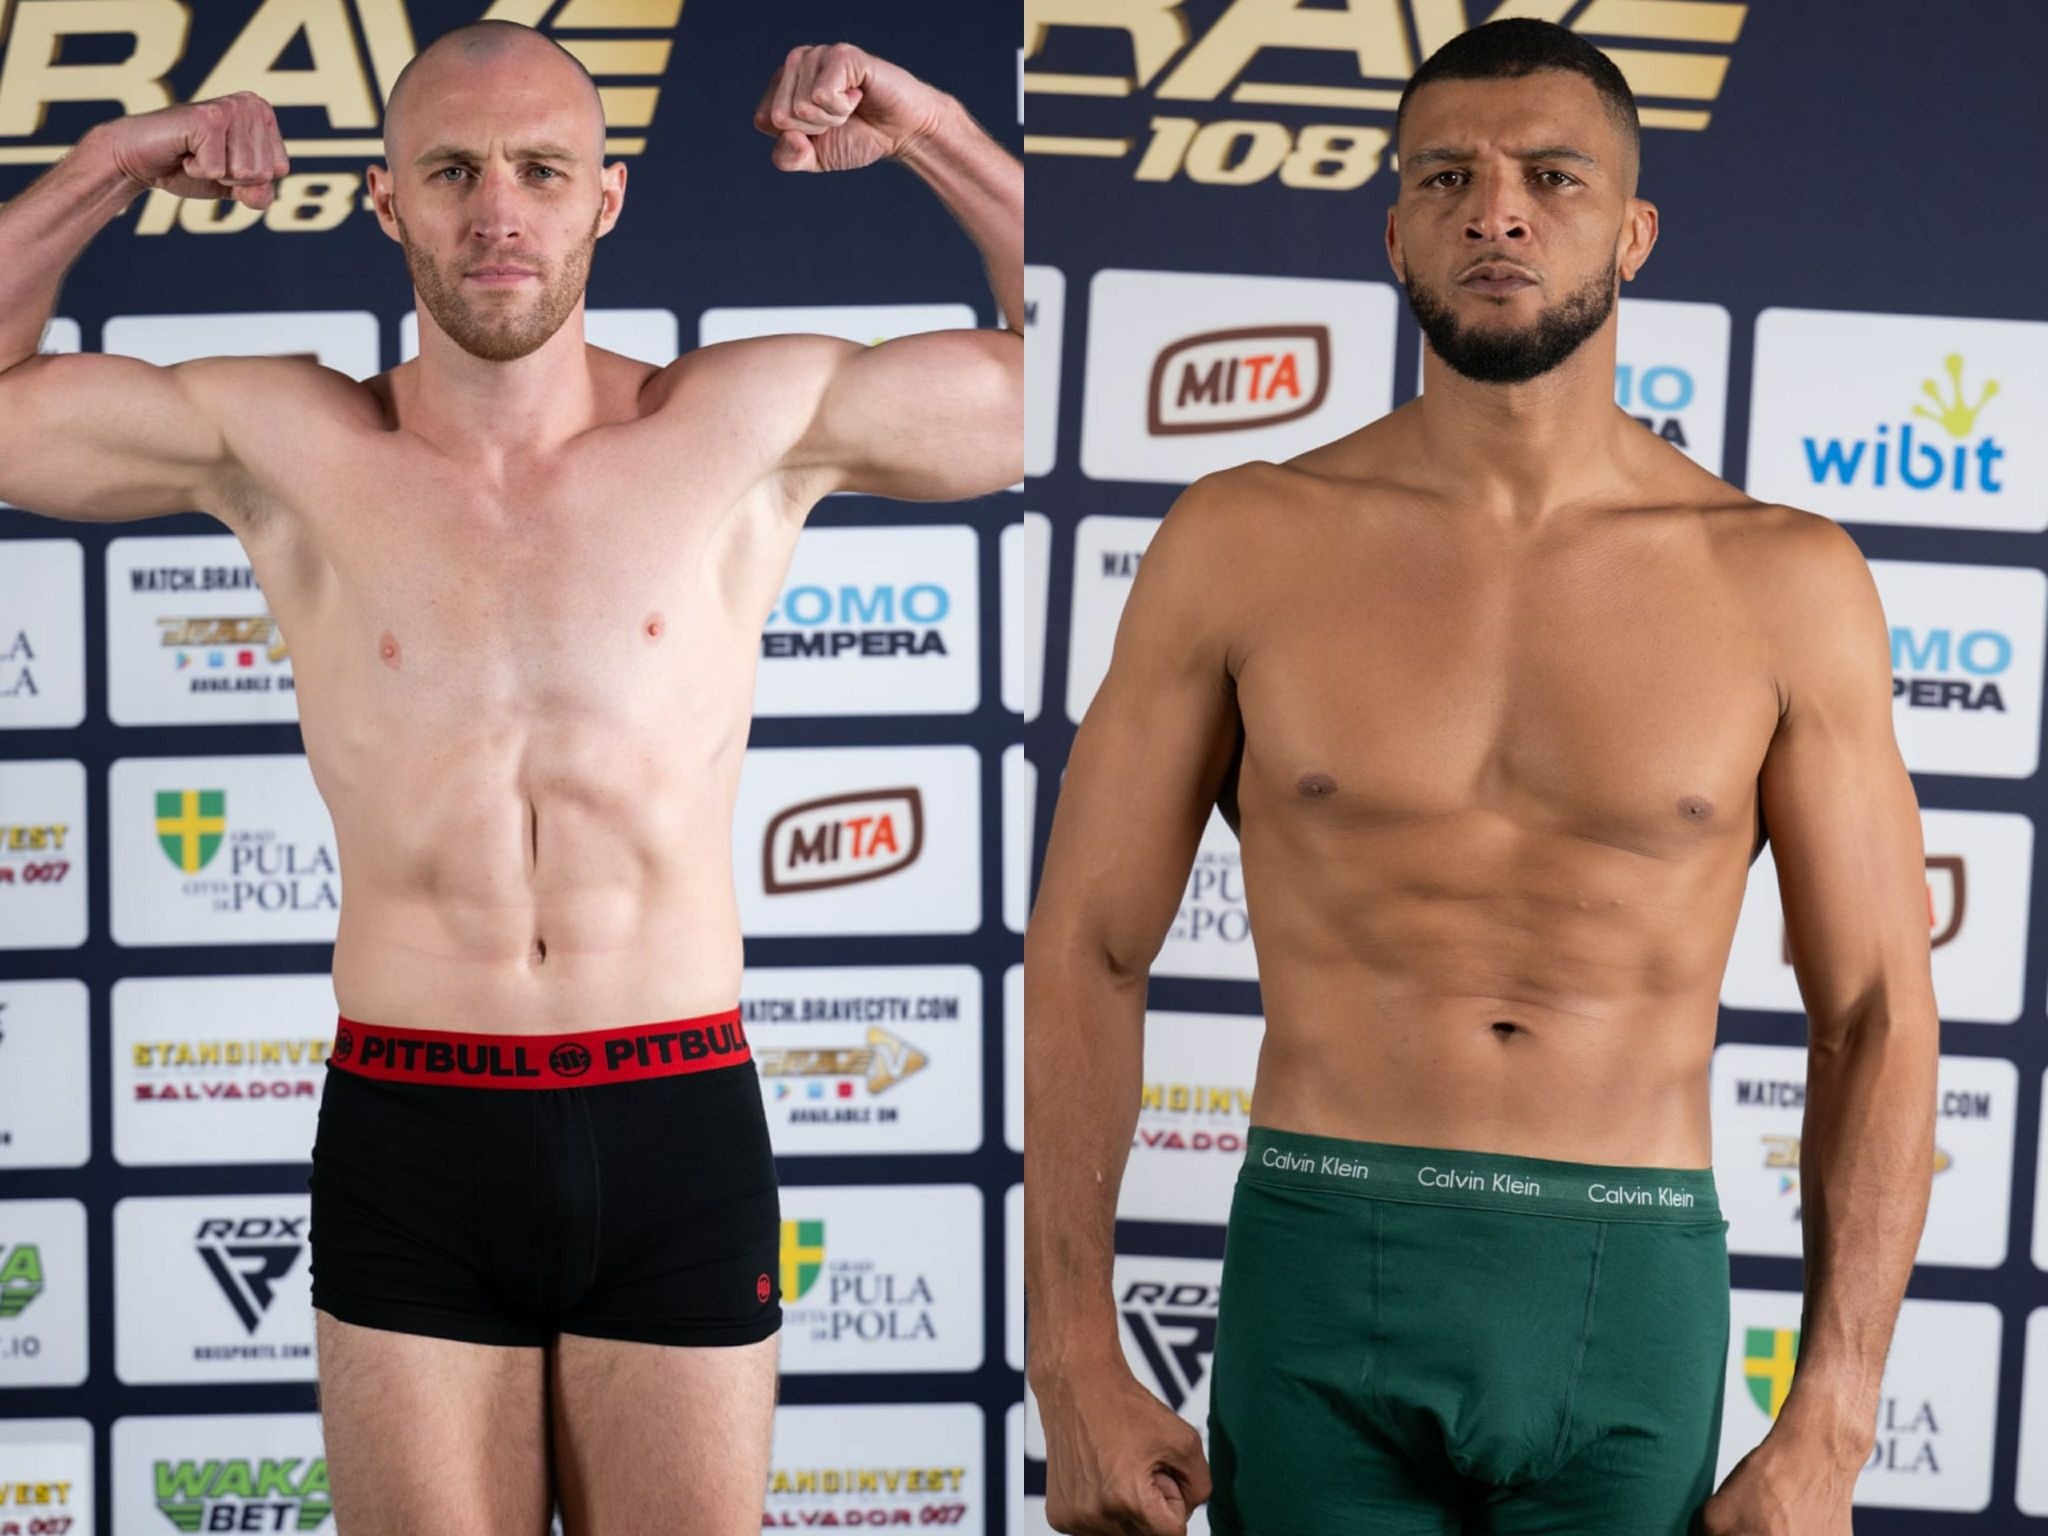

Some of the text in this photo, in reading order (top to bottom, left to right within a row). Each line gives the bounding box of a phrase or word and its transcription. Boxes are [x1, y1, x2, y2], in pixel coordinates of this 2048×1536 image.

[1134, 116, 1389, 191] 108
[135, 173, 362, 235] 108
[1175, 353, 1302, 409] MITA
[1803, 423, 2004, 494] wibit
[130, 567, 262, 592] WATCH.BRAV
[766, 584, 950, 626] OMO
[761, 630, 948, 659] EMPERA
[1890, 626, 2013, 676] MO
[190, 677, 271, 694] AVAILABLE
[787, 814, 899, 870] MITA
[231, 844, 336, 875] PULA
[232, 880, 338, 912] POLA
[1190, 907, 1250, 943] PO
[739, 996, 959, 1023] ATCH.BRAVECFTV.COM
[131, 1039, 334, 1068] STANDINVE
[359, 1035, 540, 1077] PITBULL
[133, 1081, 315, 1102] SALVADOR
[788, 1107, 870, 1124] AVAILABLE
[1262, 1147, 1695, 1208] Calvin Klein Calvin Klein Calvin Klein
[195, 1217, 306, 1240] RDX
[829, 1274, 935, 1305] PULA
[831, 1309, 938, 1341] POLA
[154, 1458, 330, 1499] WAKA
[768, 1467, 965, 1494] ANDINVEST
[208, 1503, 295, 1532] BET
[761, 1504, 966, 1527] ALVADOR 007
